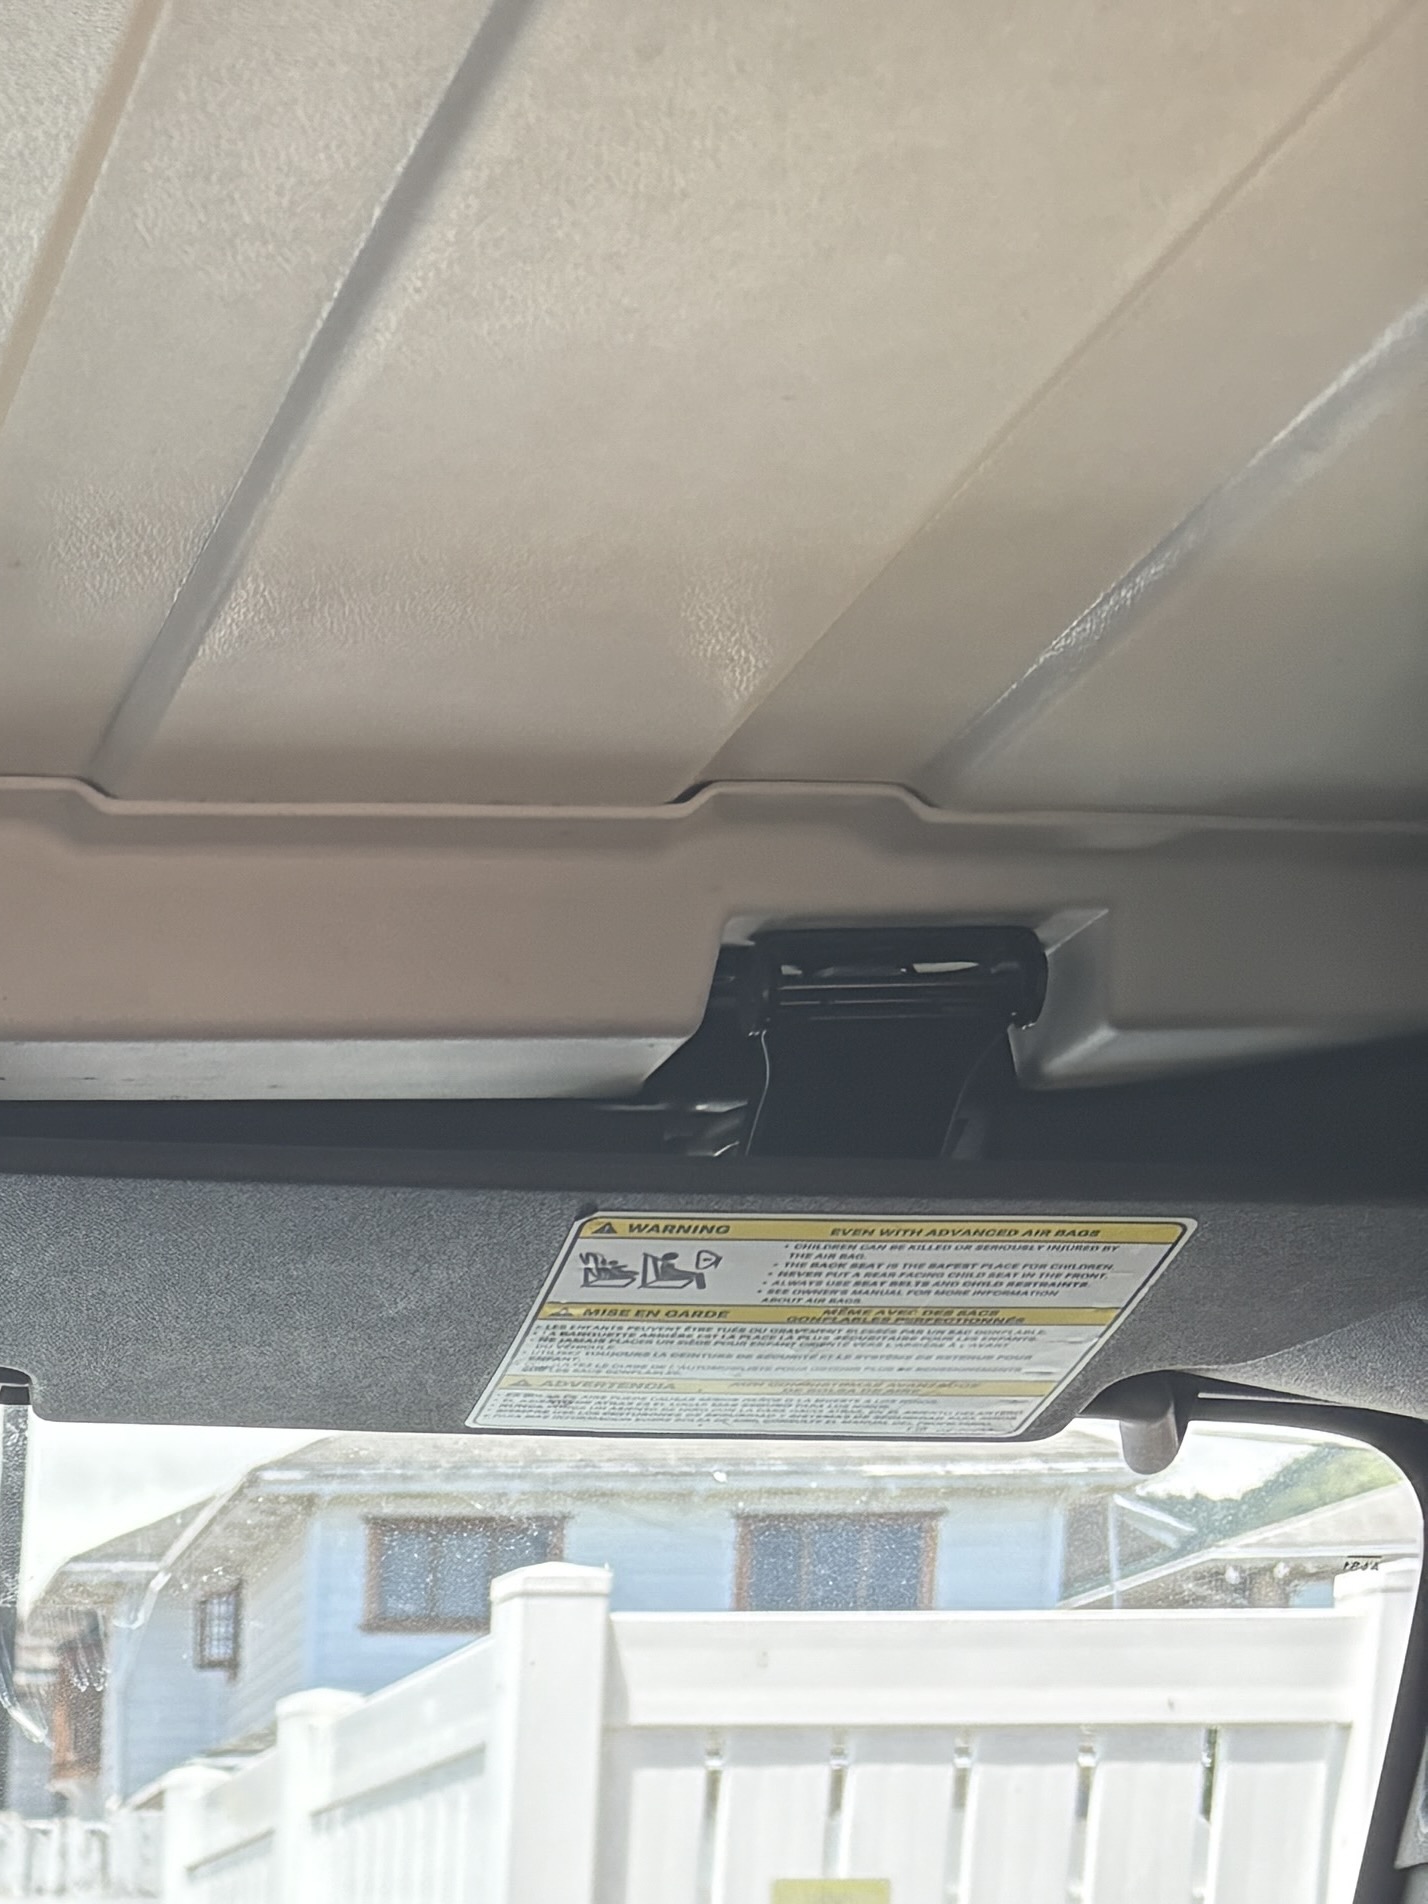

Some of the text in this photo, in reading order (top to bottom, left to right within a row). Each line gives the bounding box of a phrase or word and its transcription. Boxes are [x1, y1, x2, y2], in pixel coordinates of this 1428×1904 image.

[628, 1223, 731, 1234] WARNING
[831, 1228, 1101, 1237] EVEN WITH ADVANCED AIR BAGS
[1046, 1244, 1099, 1252] INJURED
[582, 1309, 730, 1318] MISE EN GARDE
